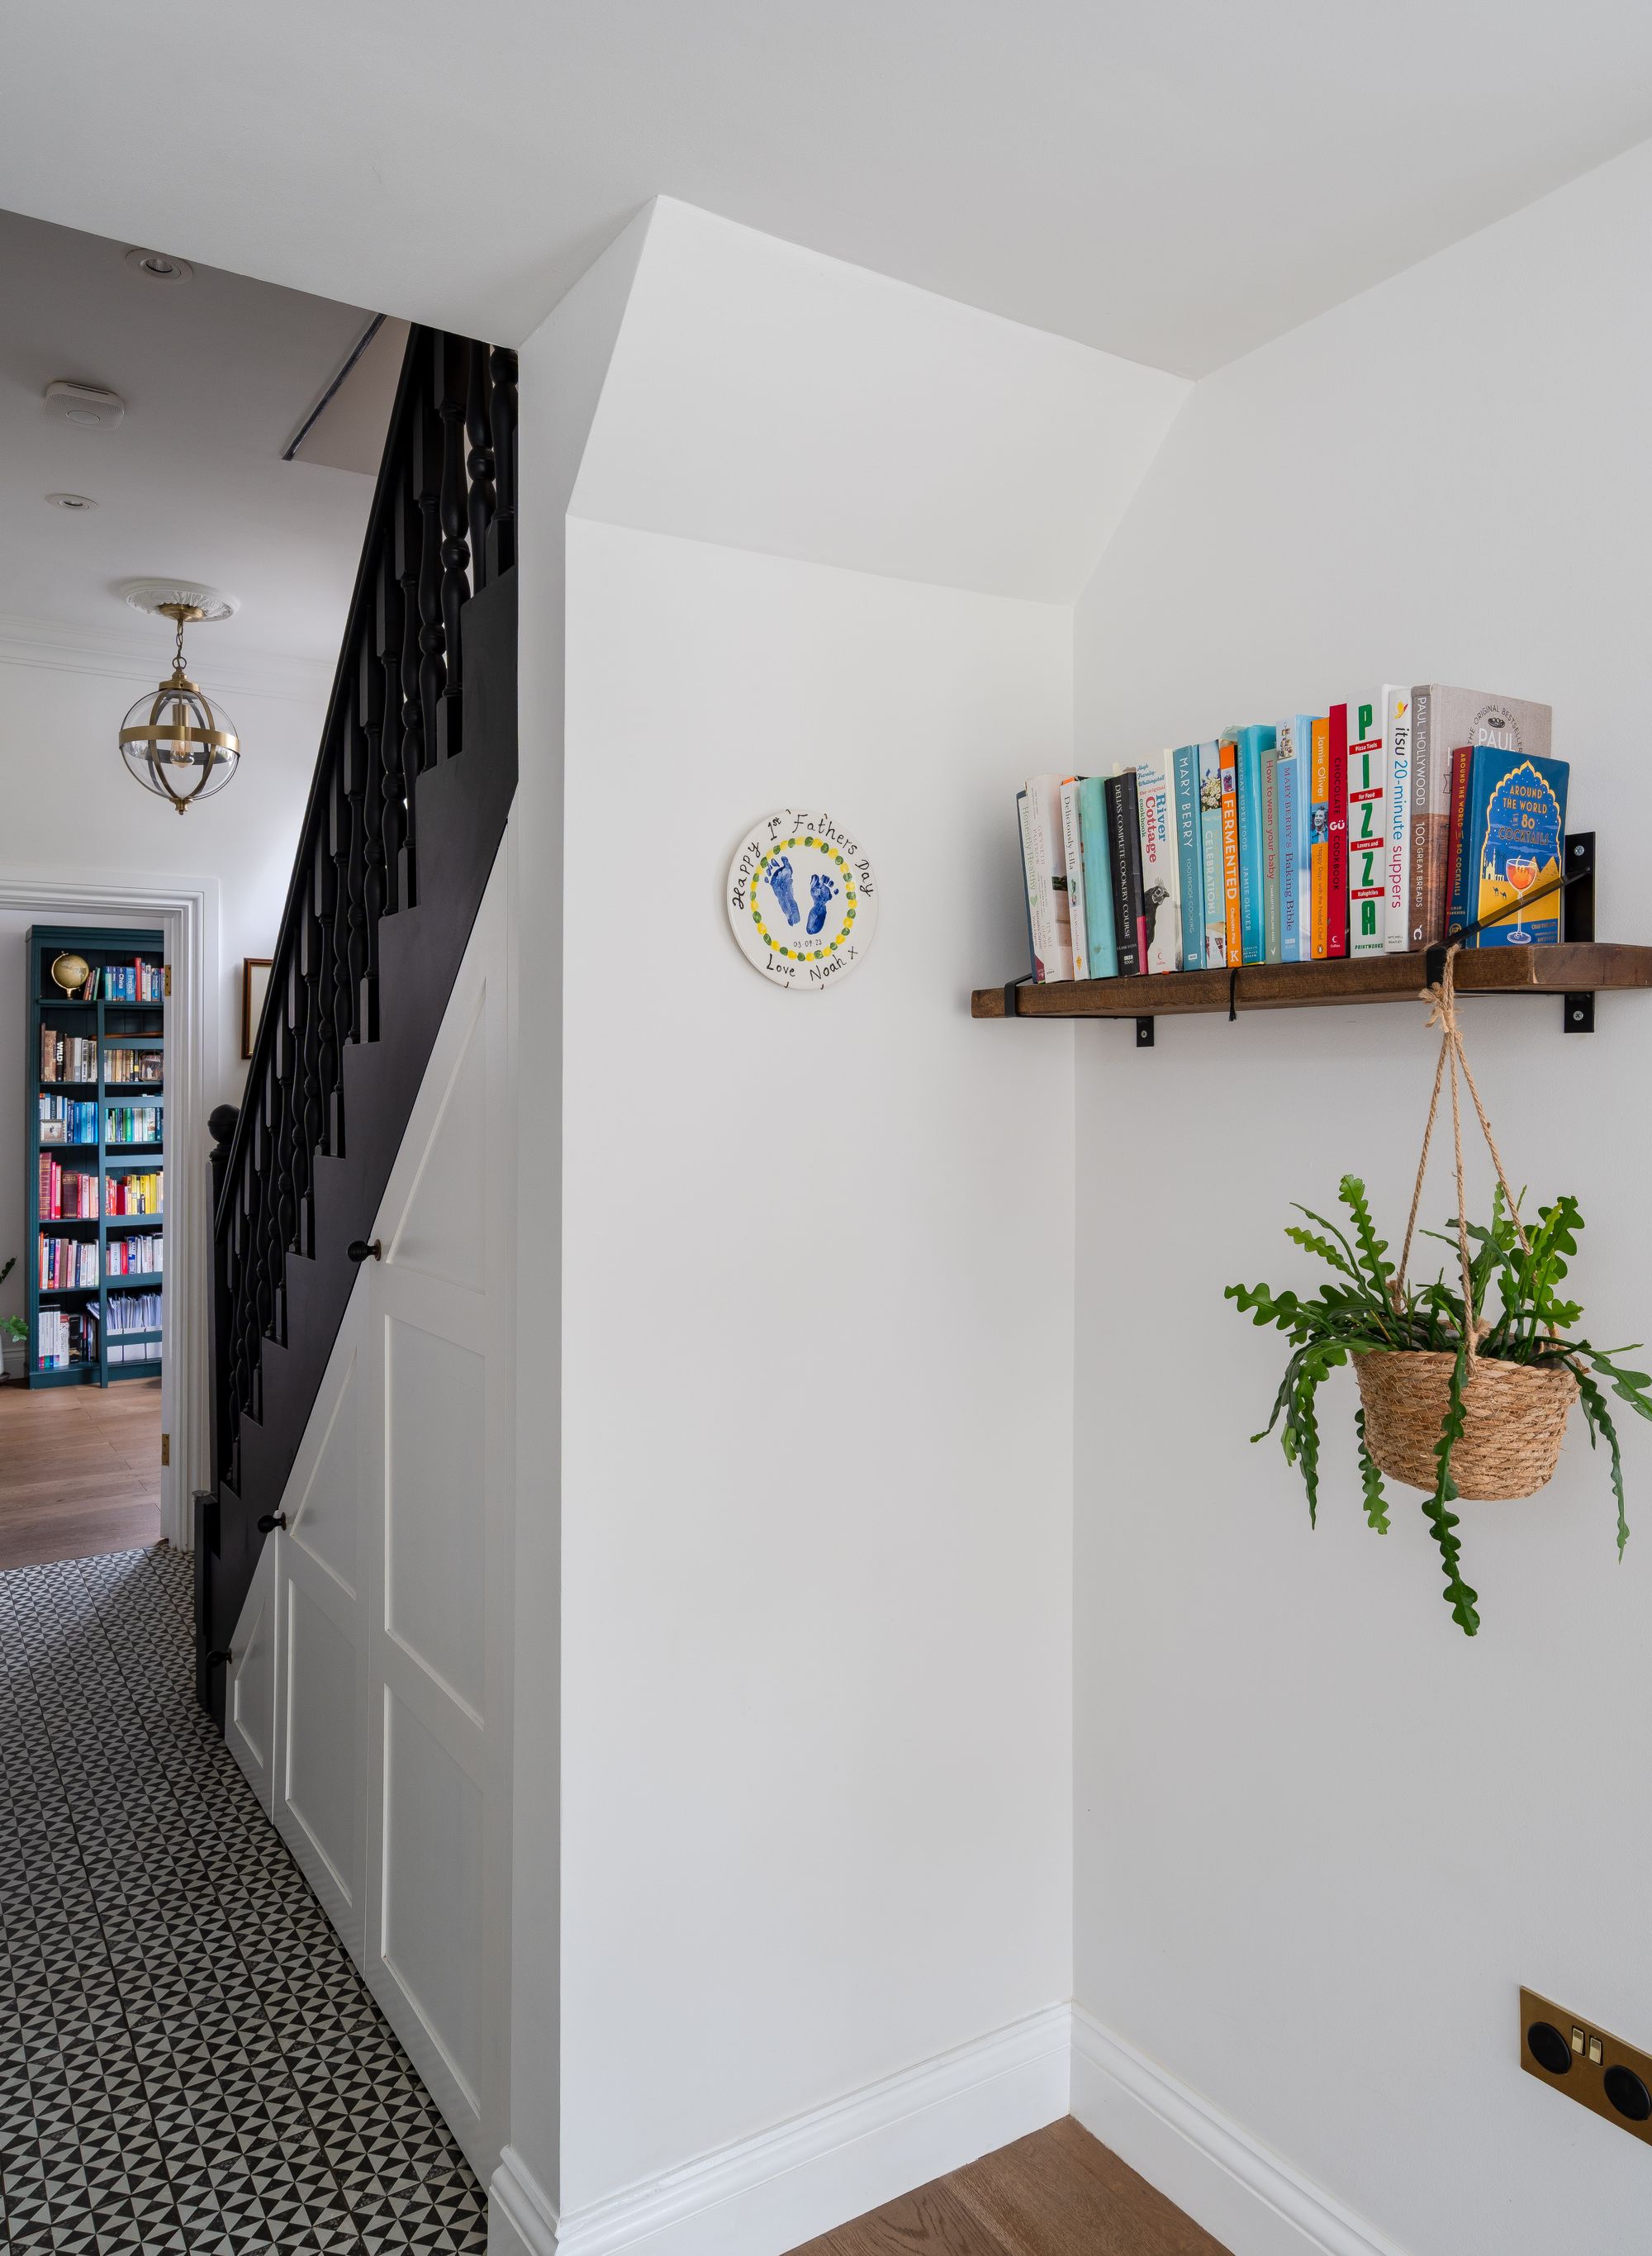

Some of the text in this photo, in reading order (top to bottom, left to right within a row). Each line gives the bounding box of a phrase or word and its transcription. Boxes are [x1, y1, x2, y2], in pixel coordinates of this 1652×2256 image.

[1467, 704, 1524, 753] THE ORIGINAL BESTSELLER
[1478, 728, 1516, 752] PAUL
[1265, 759, 1274, 784] How
[1317, 735, 1326, 797] Jamie Oliver
[1416, 696, 1427, 805] PAUL HOLLYWOOD
[1147, 785, 1165, 793] original
[1179, 757, 1193, 848] MARY BERRY
[1266, 786, 1274, 797] to
[1333, 758, 1341, 815] CHOCOLATE
[1502, 797, 1548, 814] THE WORLD
[1509, 785, 1543, 800] AROUND
[1064, 796, 1076, 871] Deliciously Ella
[1117, 815, 1126, 859] COMPLETE
[1145, 796, 1157, 863] Cottage
[1156, 793, 1166, 842] River
[1389, 727, 1410, 909] itsu 20-minute suppers
[1415, 821, 1426, 846] 100
[1498, 827, 1550, 845] COCKTAILS
[1521, 814, 1536, 829] 80
[1023, 806, 1036, 891] Honestly Healthy
[1224, 799, 1237, 900] FERMENTED
[1265, 829, 1274, 851] your
[732, 841, 762, 910] Happy
[854, 859, 874, 897] Day
[1119, 860, 1128, 901] COOKERY
[1205, 830, 1216, 914] CELEBRATIONS
[1267, 853, 1276, 880] baby
[1284, 853, 1294, 898] Baking
[1332, 836, 1341, 891] COOKBOOK
[1454, 857, 1463, 896] COCKTAILS
[1123, 904, 1131, 939] COURSE
[1286, 900, 1294, 931] Bible
[766, 953, 795, 977] Love
[809, 954, 847, 981] Noah
